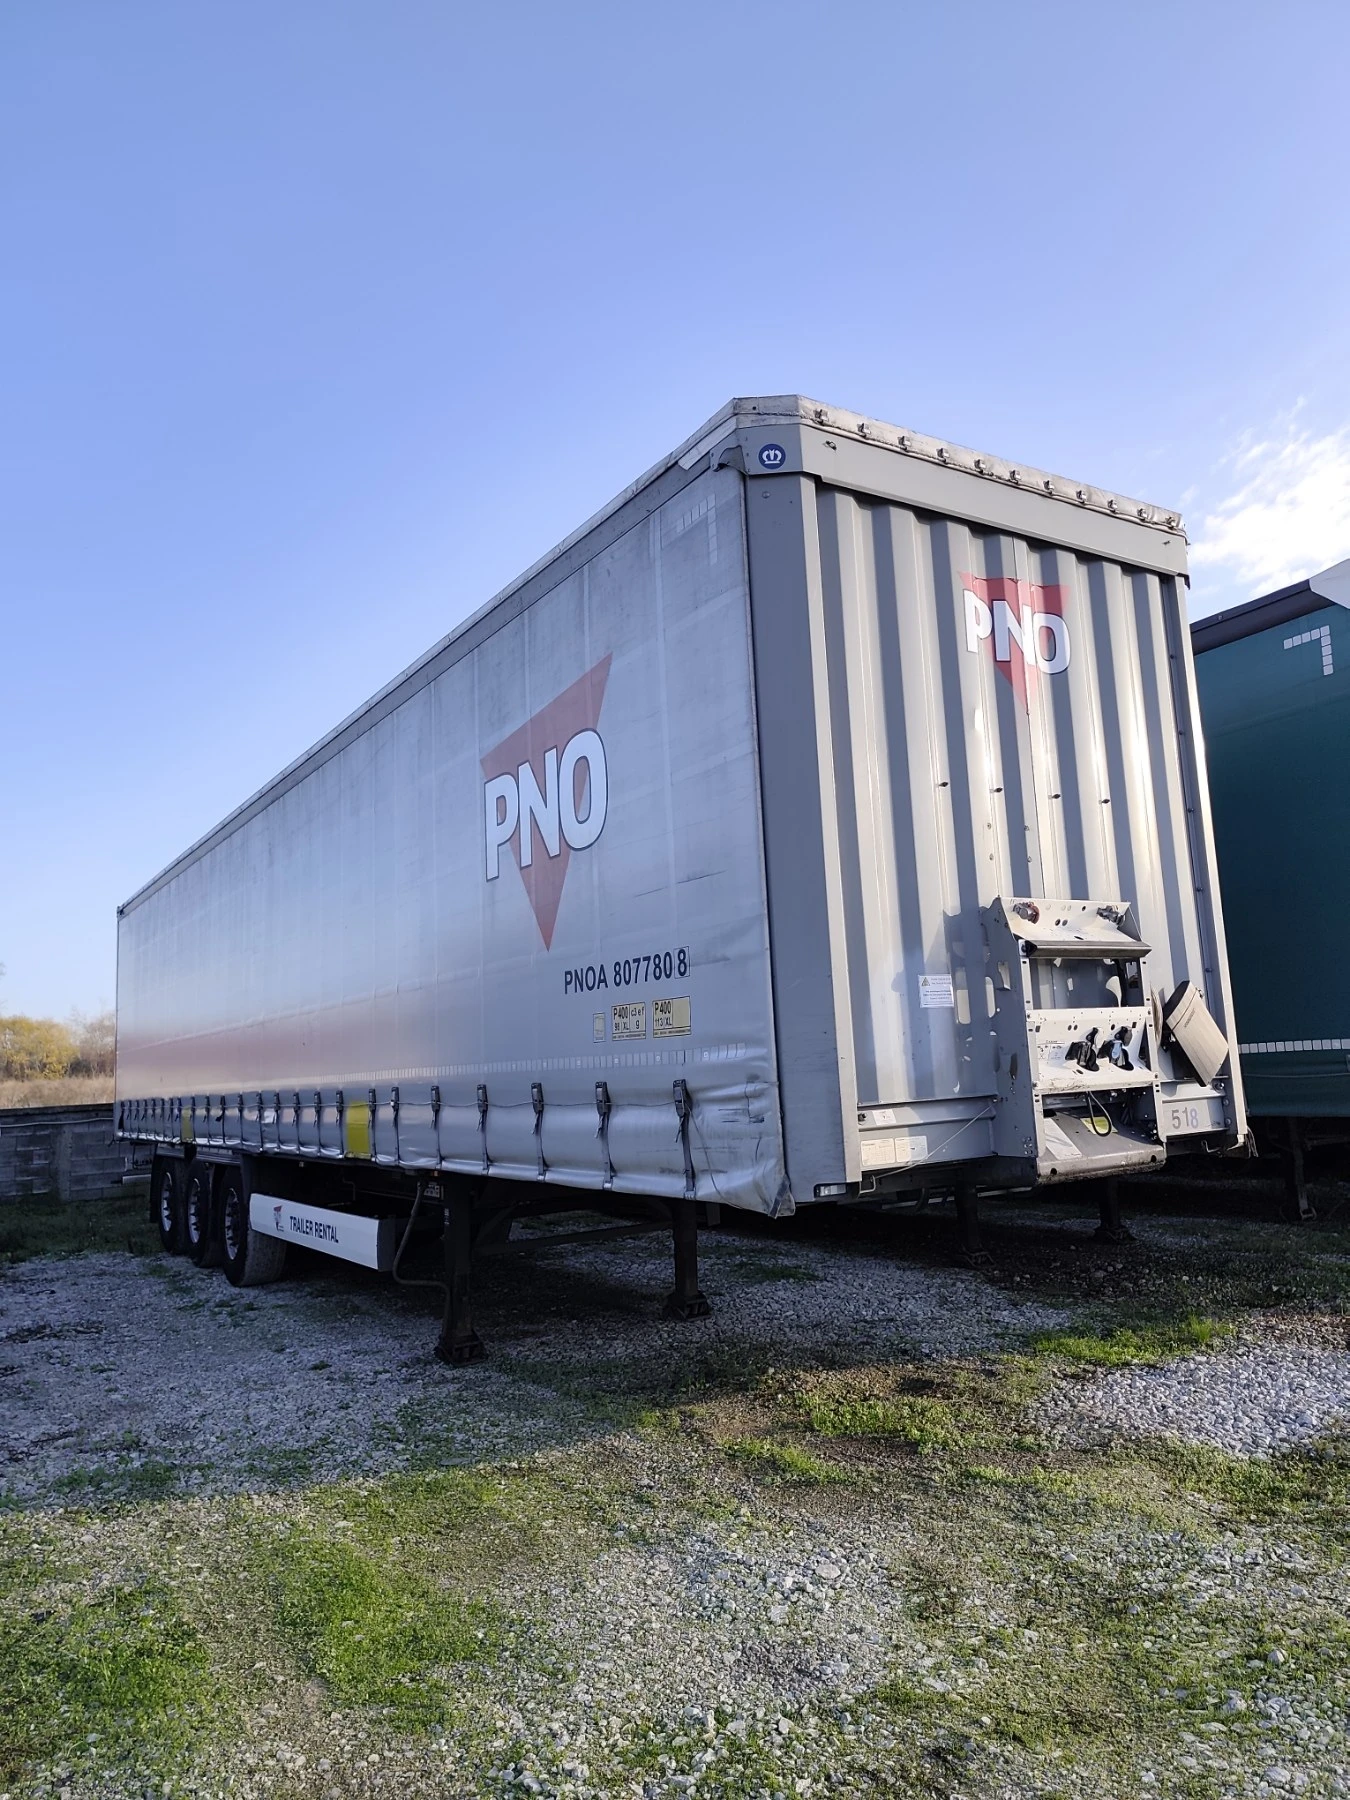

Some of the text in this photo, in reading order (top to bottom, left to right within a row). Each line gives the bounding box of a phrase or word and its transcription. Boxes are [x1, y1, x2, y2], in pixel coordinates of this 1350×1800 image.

[963, 589, 1071, 675] PNO
[484, 727, 608, 882] PNO
[564, 964, 608, 995] PNOA
[1171, 1107, 1199, 1130] 518
[289, 1216, 314, 1237] TRAILER
[314, 1221, 339, 1244] RENTAL
